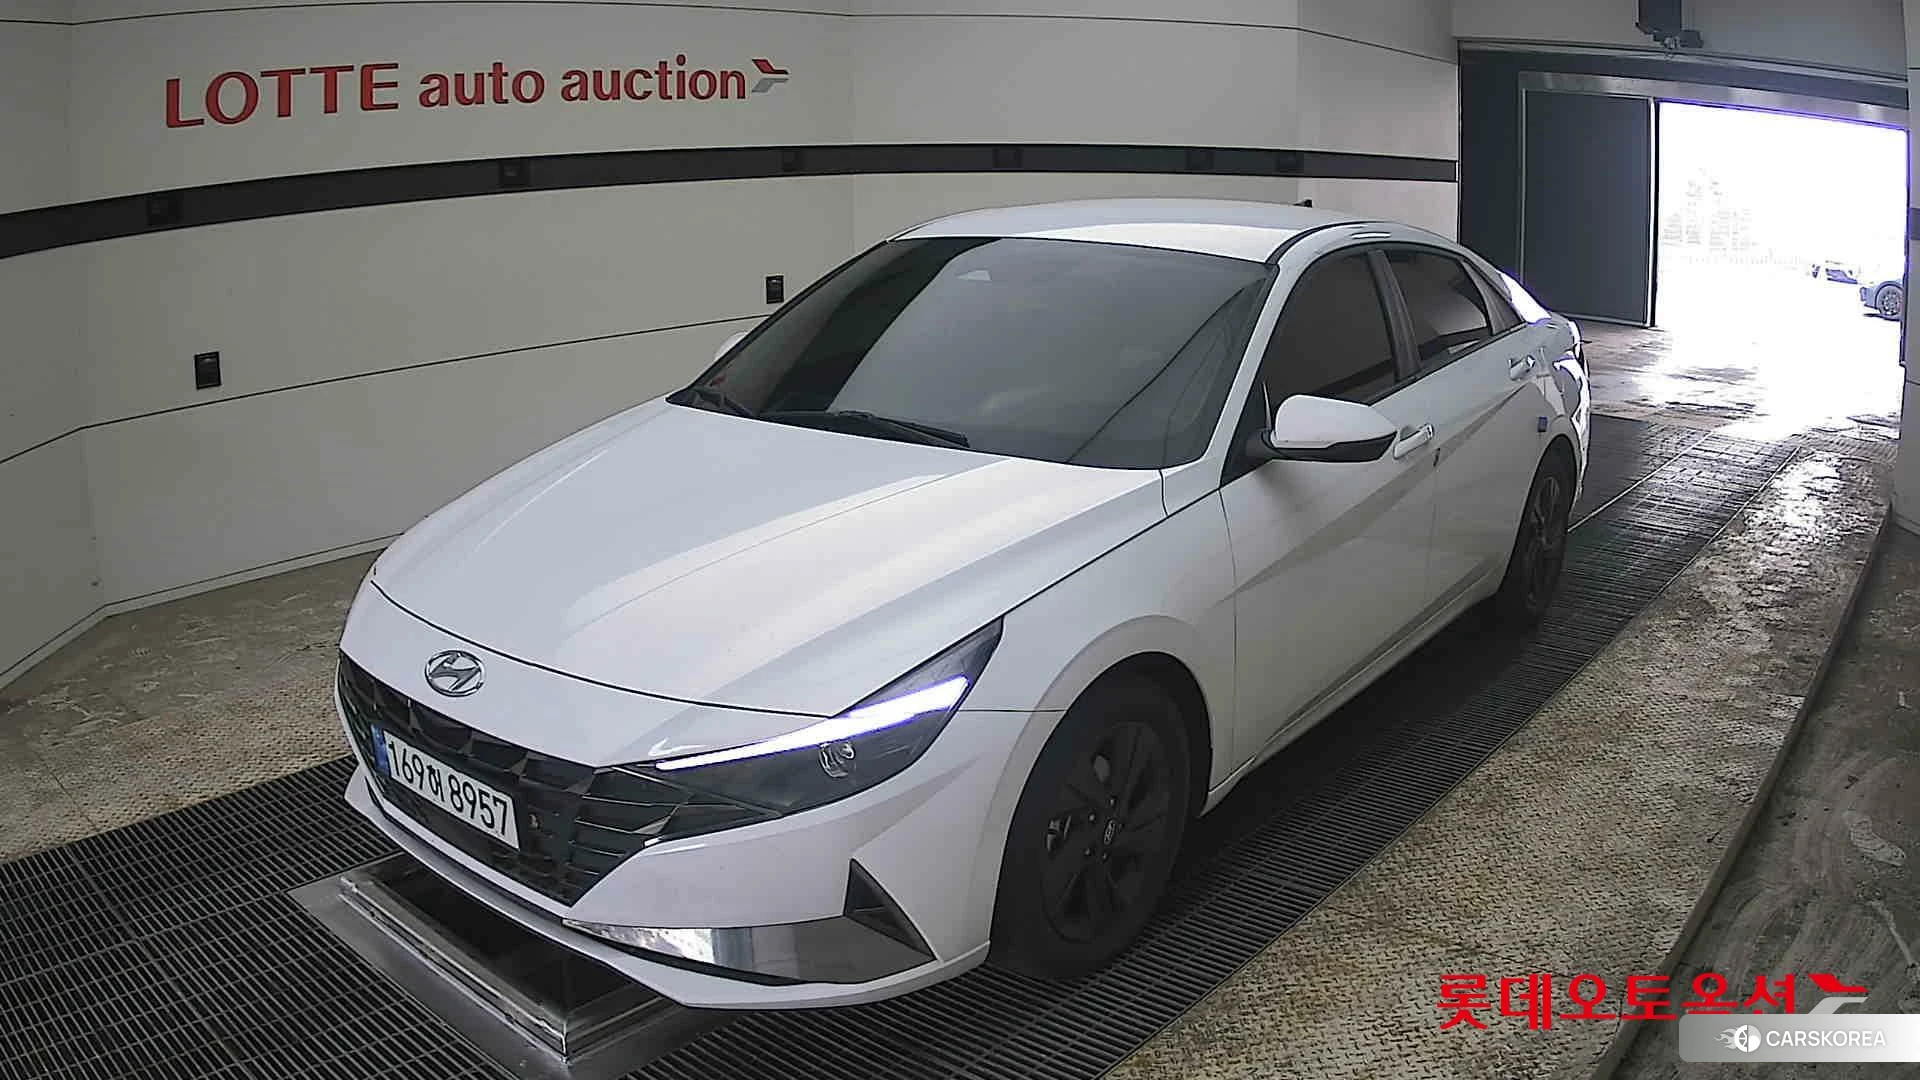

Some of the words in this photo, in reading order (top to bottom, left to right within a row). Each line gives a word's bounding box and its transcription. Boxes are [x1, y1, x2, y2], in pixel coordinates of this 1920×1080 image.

[166, 63, 399, 128] LOTTE
[419, 62, 545, 108] auto
[561, 54, 747, 102] auction
